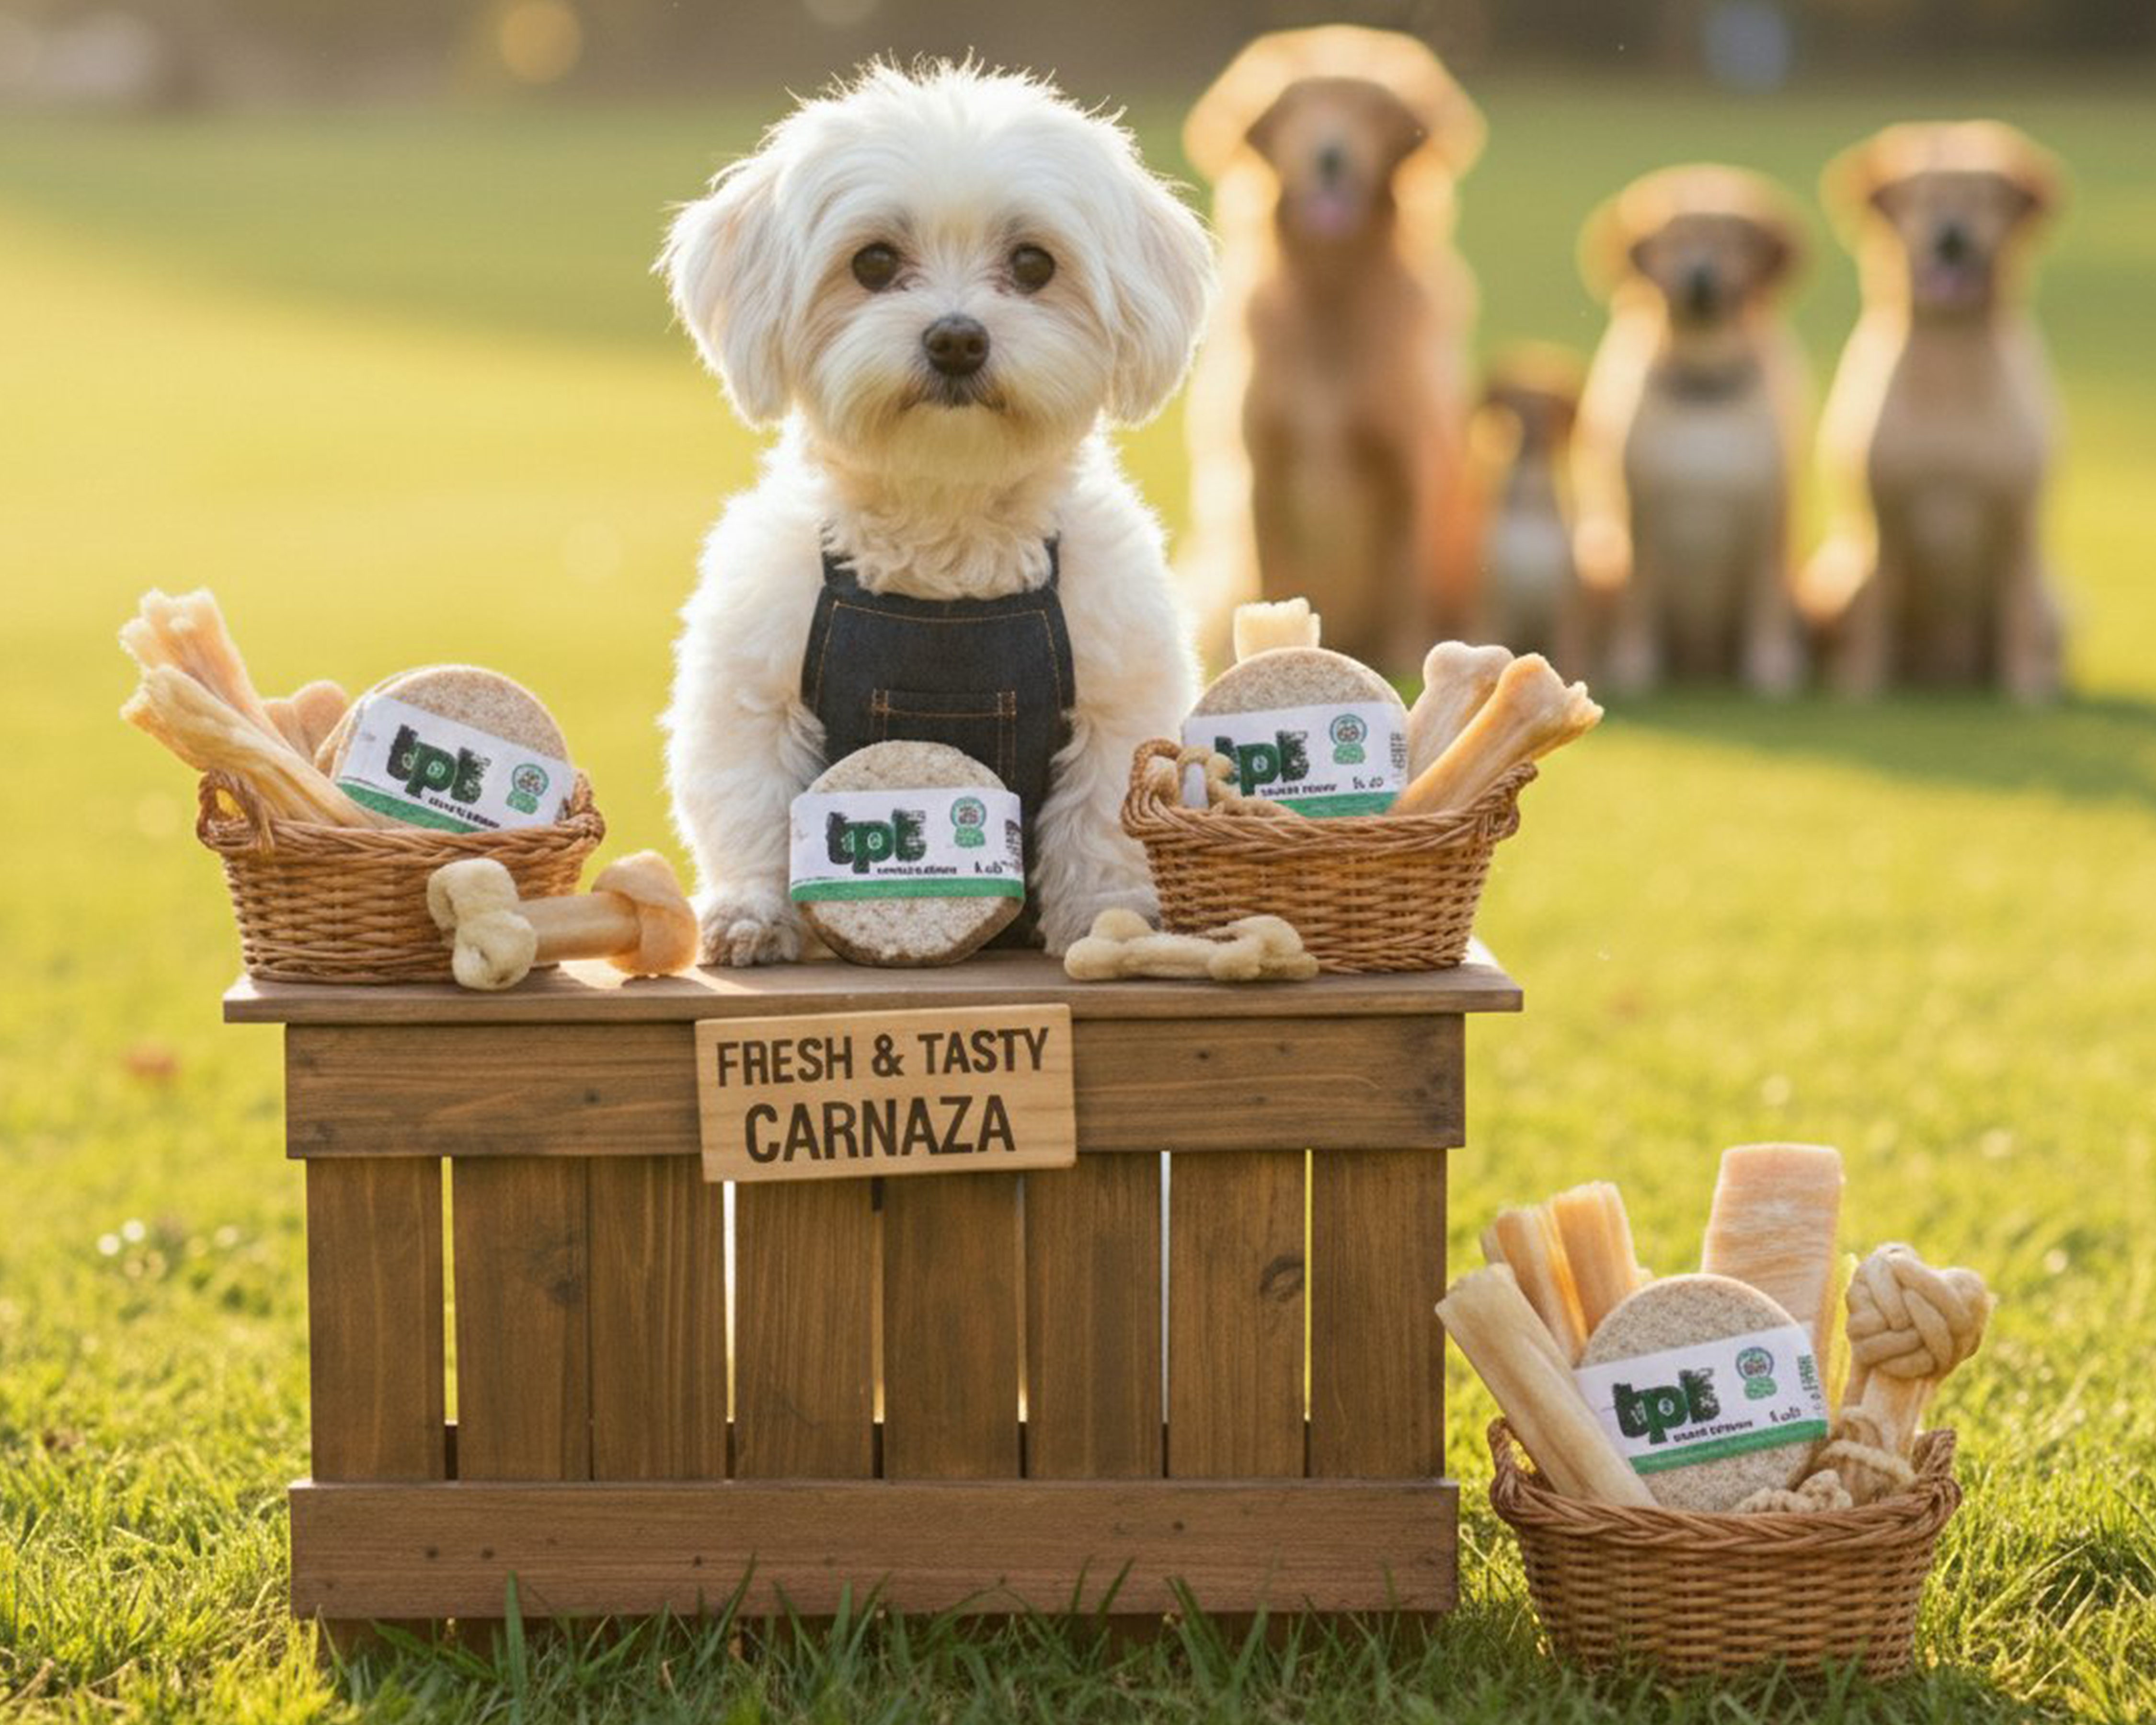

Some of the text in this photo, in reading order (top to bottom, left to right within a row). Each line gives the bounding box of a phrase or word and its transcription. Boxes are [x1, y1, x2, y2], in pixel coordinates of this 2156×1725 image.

[716, 1027, 1049, 1087] FRESH & TASTY
[745, 1094, 1016, 1163] CARNAZA
